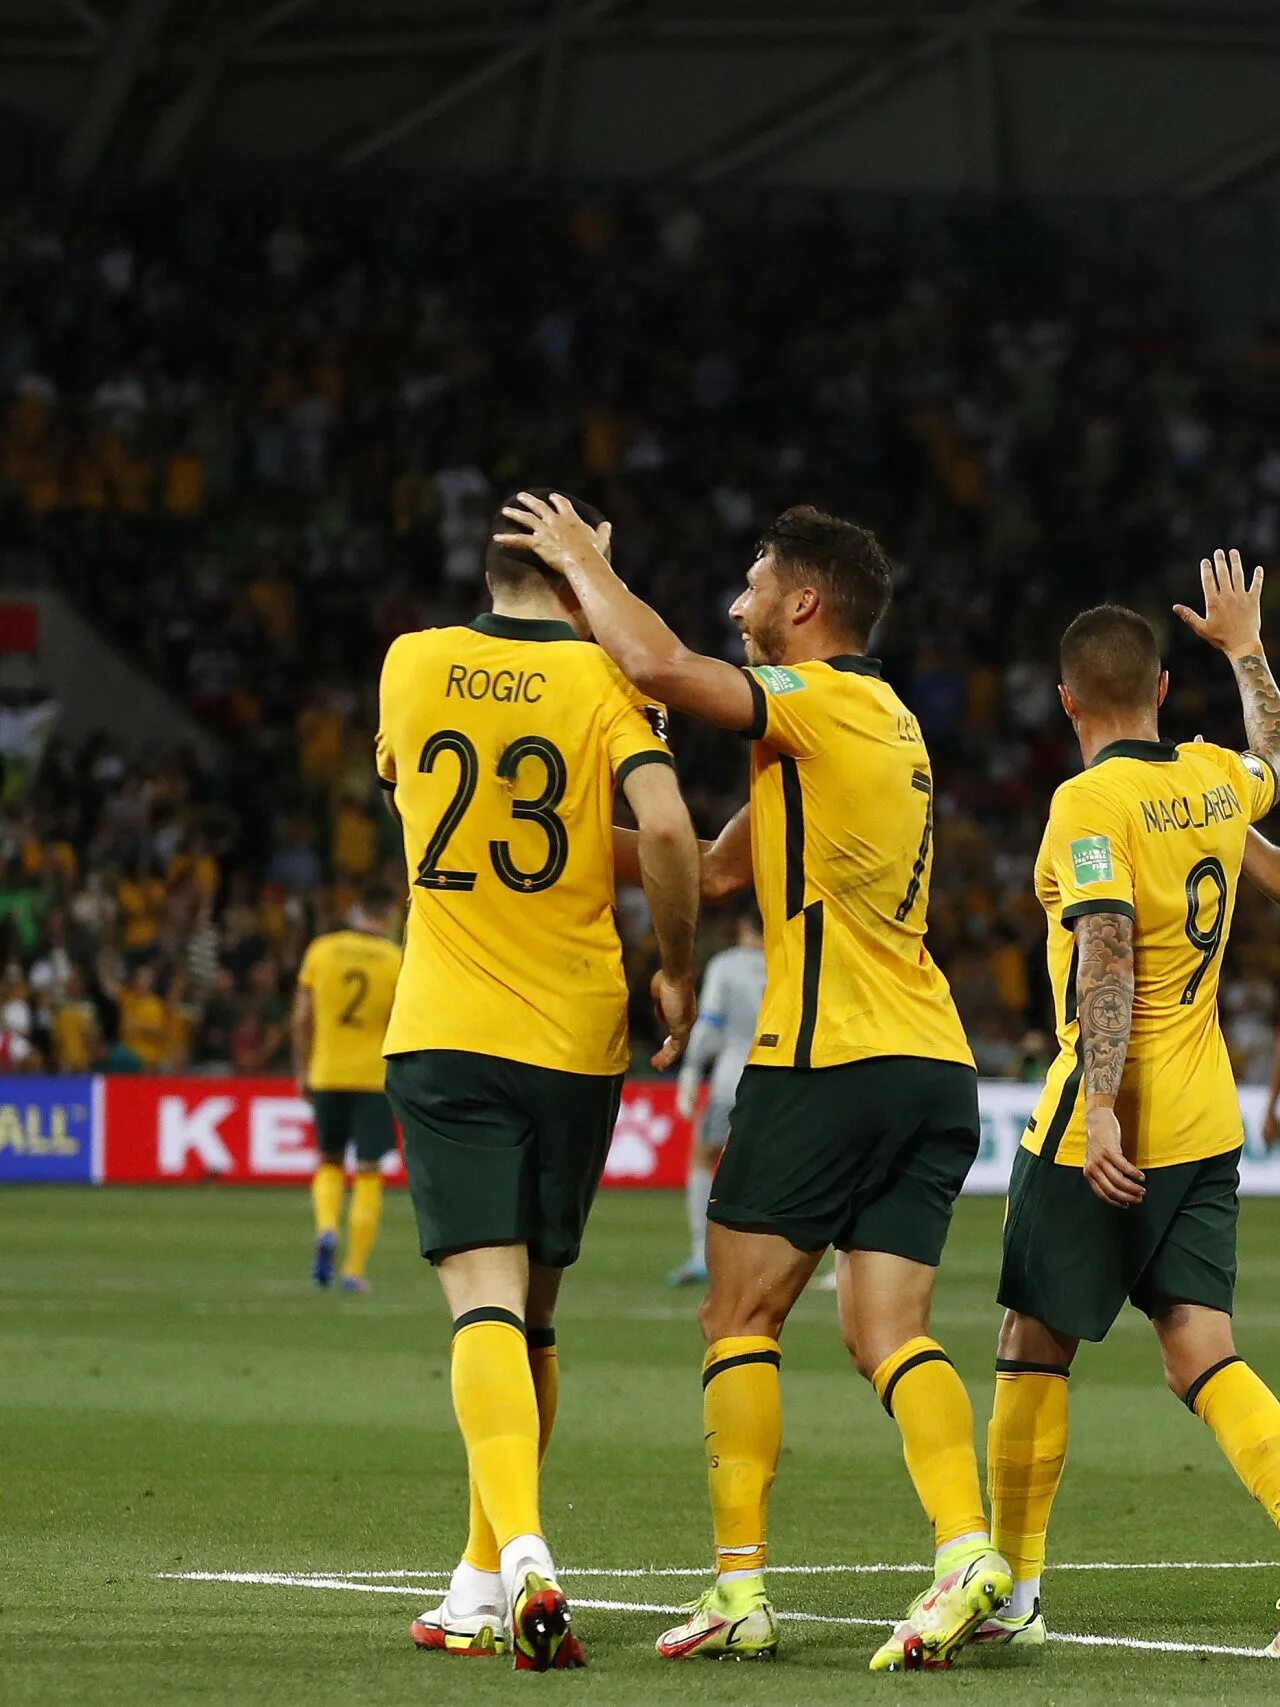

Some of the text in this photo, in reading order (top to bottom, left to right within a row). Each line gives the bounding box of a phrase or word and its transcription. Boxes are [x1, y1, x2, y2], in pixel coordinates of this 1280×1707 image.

[445, 664, 547, 704] ROGIC
[413, 728, 570, 893] 23
[895, 767, 933, 923] 7
[1139, 783, 1242, 833] MACLAREN
[1179, 856, 1228, 1005] 9
[339, 967, 370, 1028] 2
